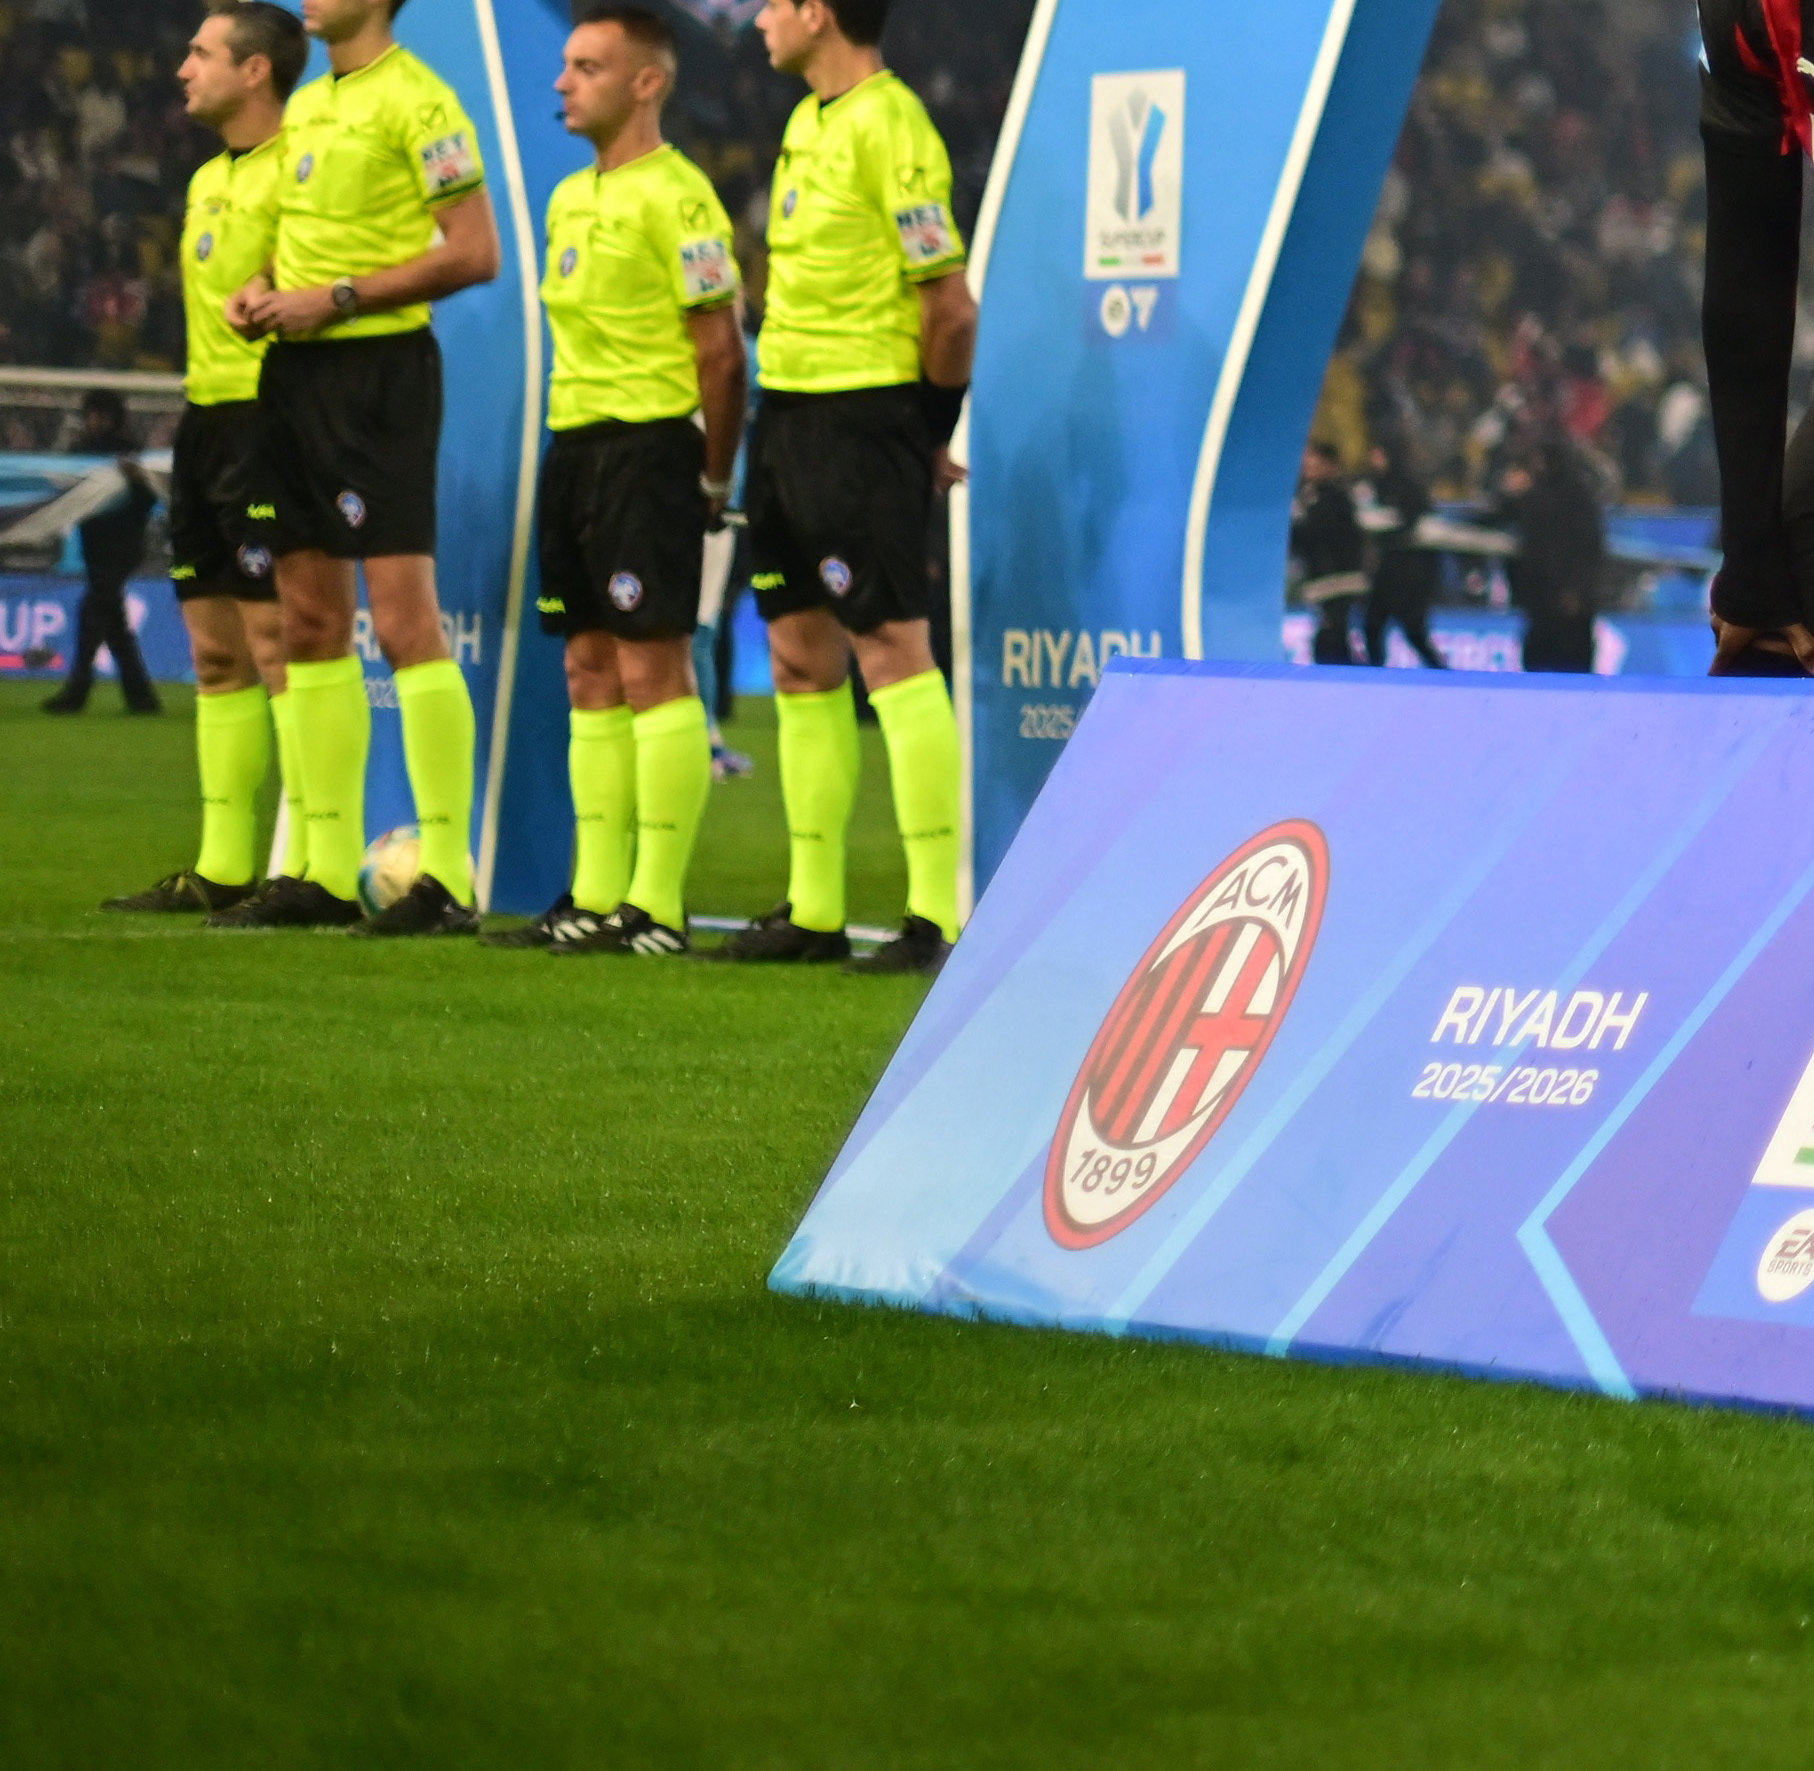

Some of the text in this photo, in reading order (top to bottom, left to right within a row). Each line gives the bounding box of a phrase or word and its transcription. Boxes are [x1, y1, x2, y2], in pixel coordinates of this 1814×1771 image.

[1190, 855, 1303, 932] ACM
[1431, 986, 1648, 1051] RIYADH
[1411, 1062, 1599, 1105] 2025/2026
[1070, 1150, 1157, 1195] 1899
[1767, 1259, 1813, 1277] SPORTS
